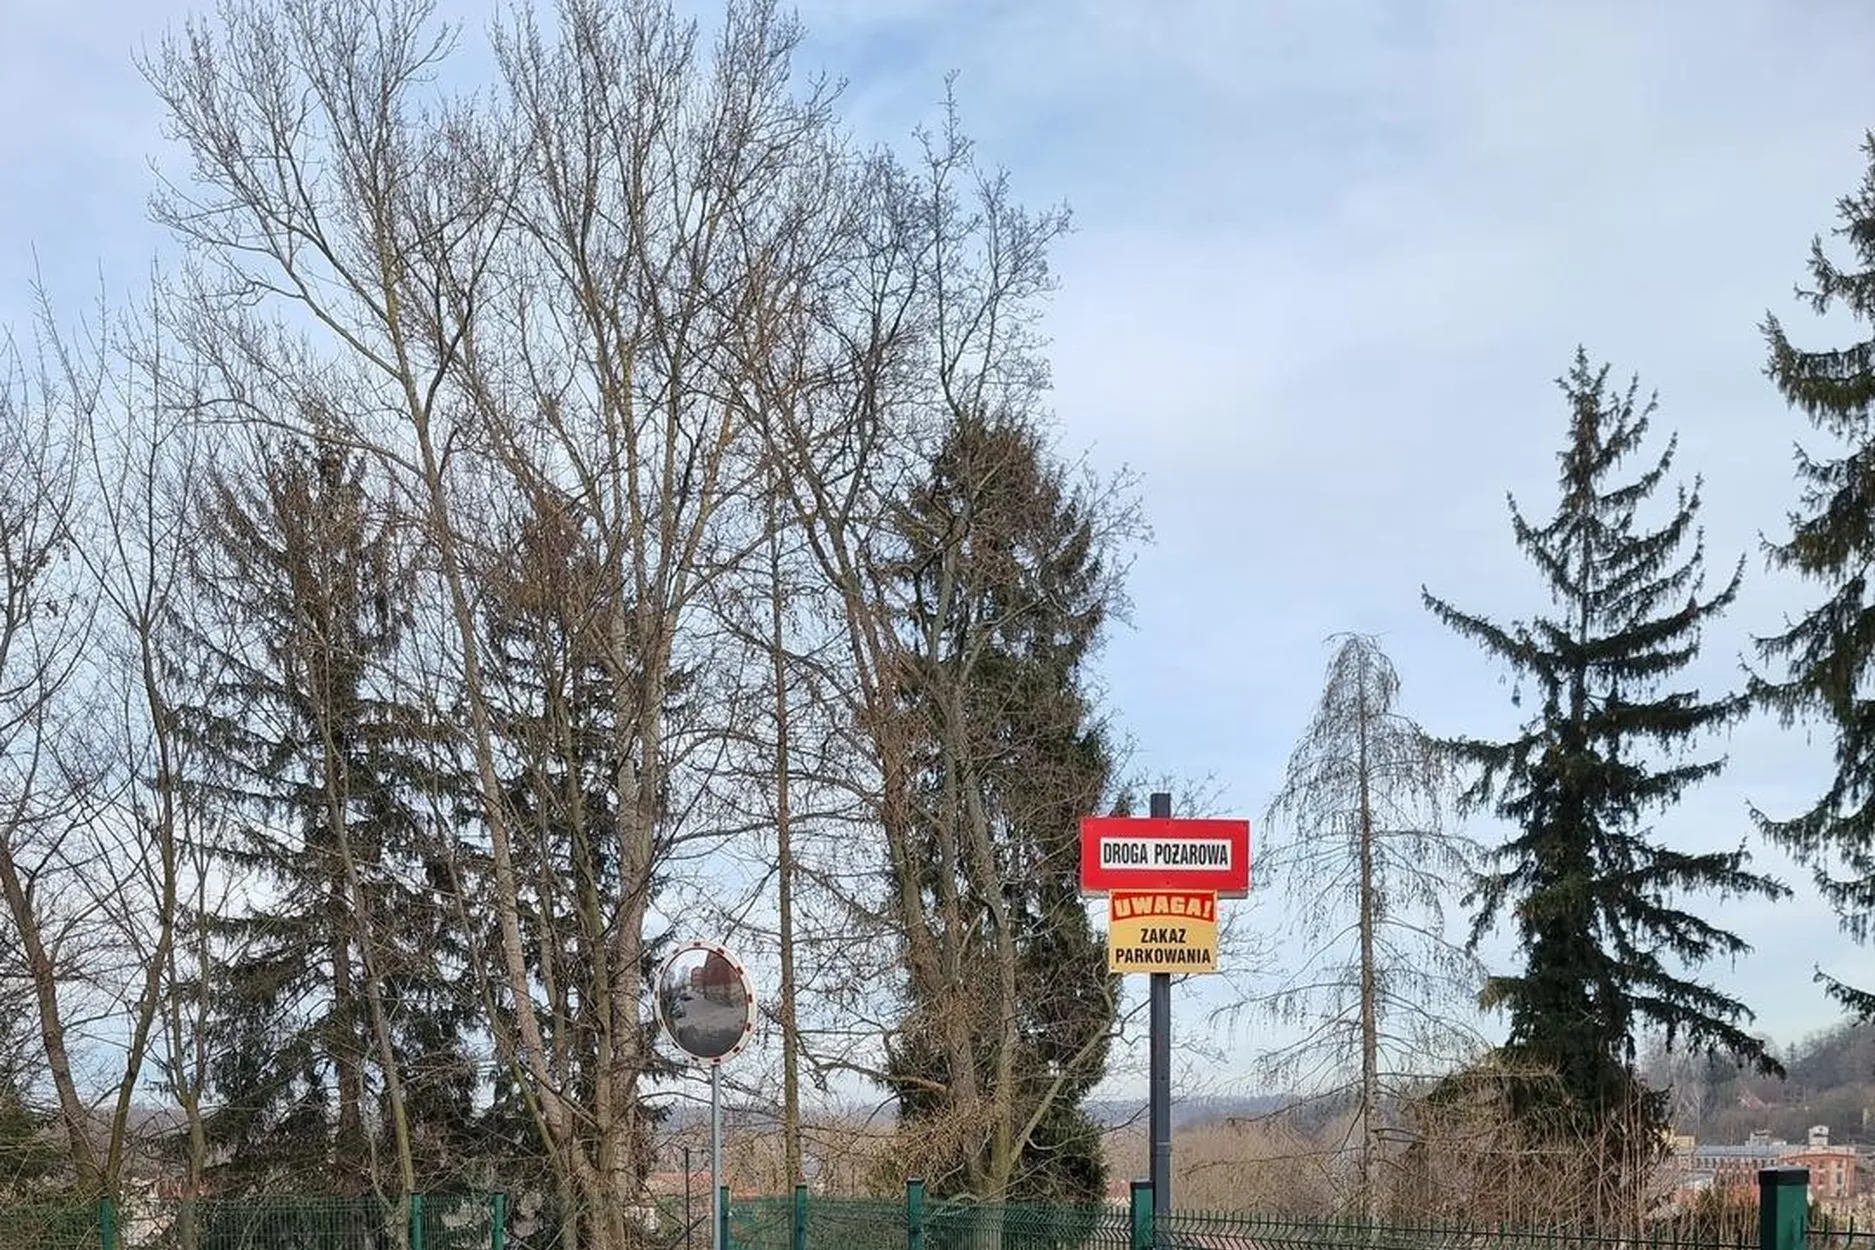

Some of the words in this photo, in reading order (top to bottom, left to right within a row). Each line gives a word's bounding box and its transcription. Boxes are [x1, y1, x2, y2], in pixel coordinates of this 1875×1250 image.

[1103, 842, 1148, 865] DROGA
[1113, 895, 1214, 919] UWAGA!
[1140, 928, 1187, 944] ZAKAZ
[1115, 948, 1212, 964] PARKOWANIA
